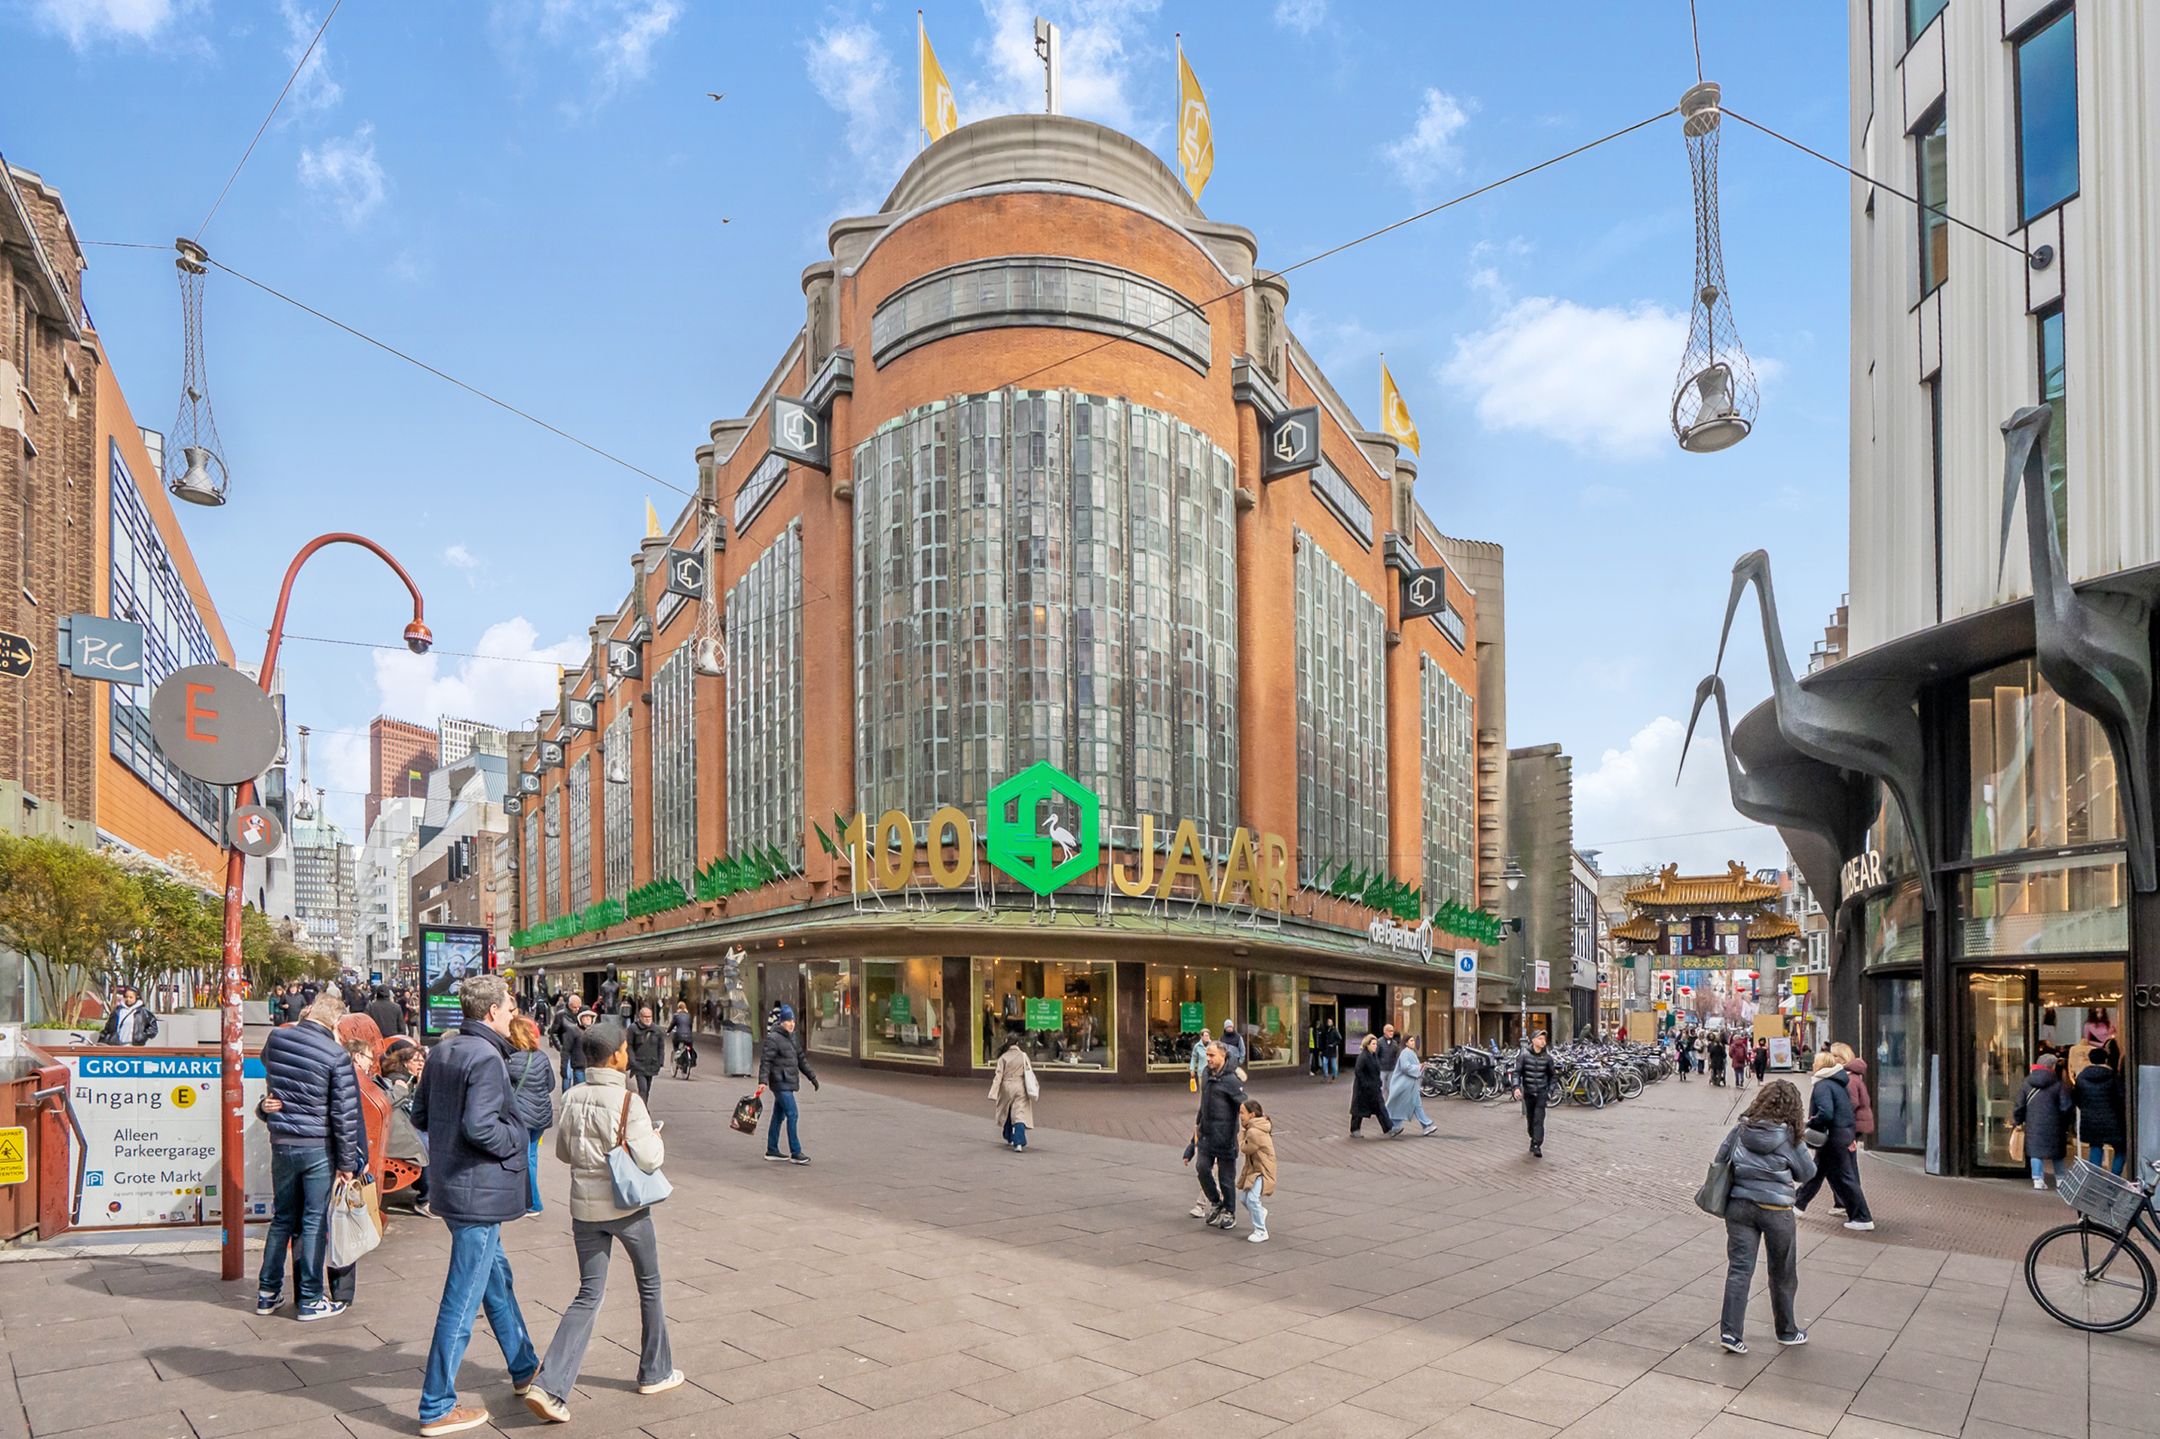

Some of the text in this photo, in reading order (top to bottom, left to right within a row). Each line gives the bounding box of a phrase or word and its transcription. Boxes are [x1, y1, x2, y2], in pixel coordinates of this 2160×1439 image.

[186, 682, 218, 743] E
[843, 806, 1288, 909] 100 JAAR
[1841, 849, 1882, 902] BEAR
[86, 1059, 222, 1075] GROT MARKT
[88, 1088, 189, 1109] Ingang E
[114, 1128, 159, 1142] Alleen
[114, 1144, 216, 1160] Parkeergarage
[114, 1169, 203, 1184] Grote Markt
